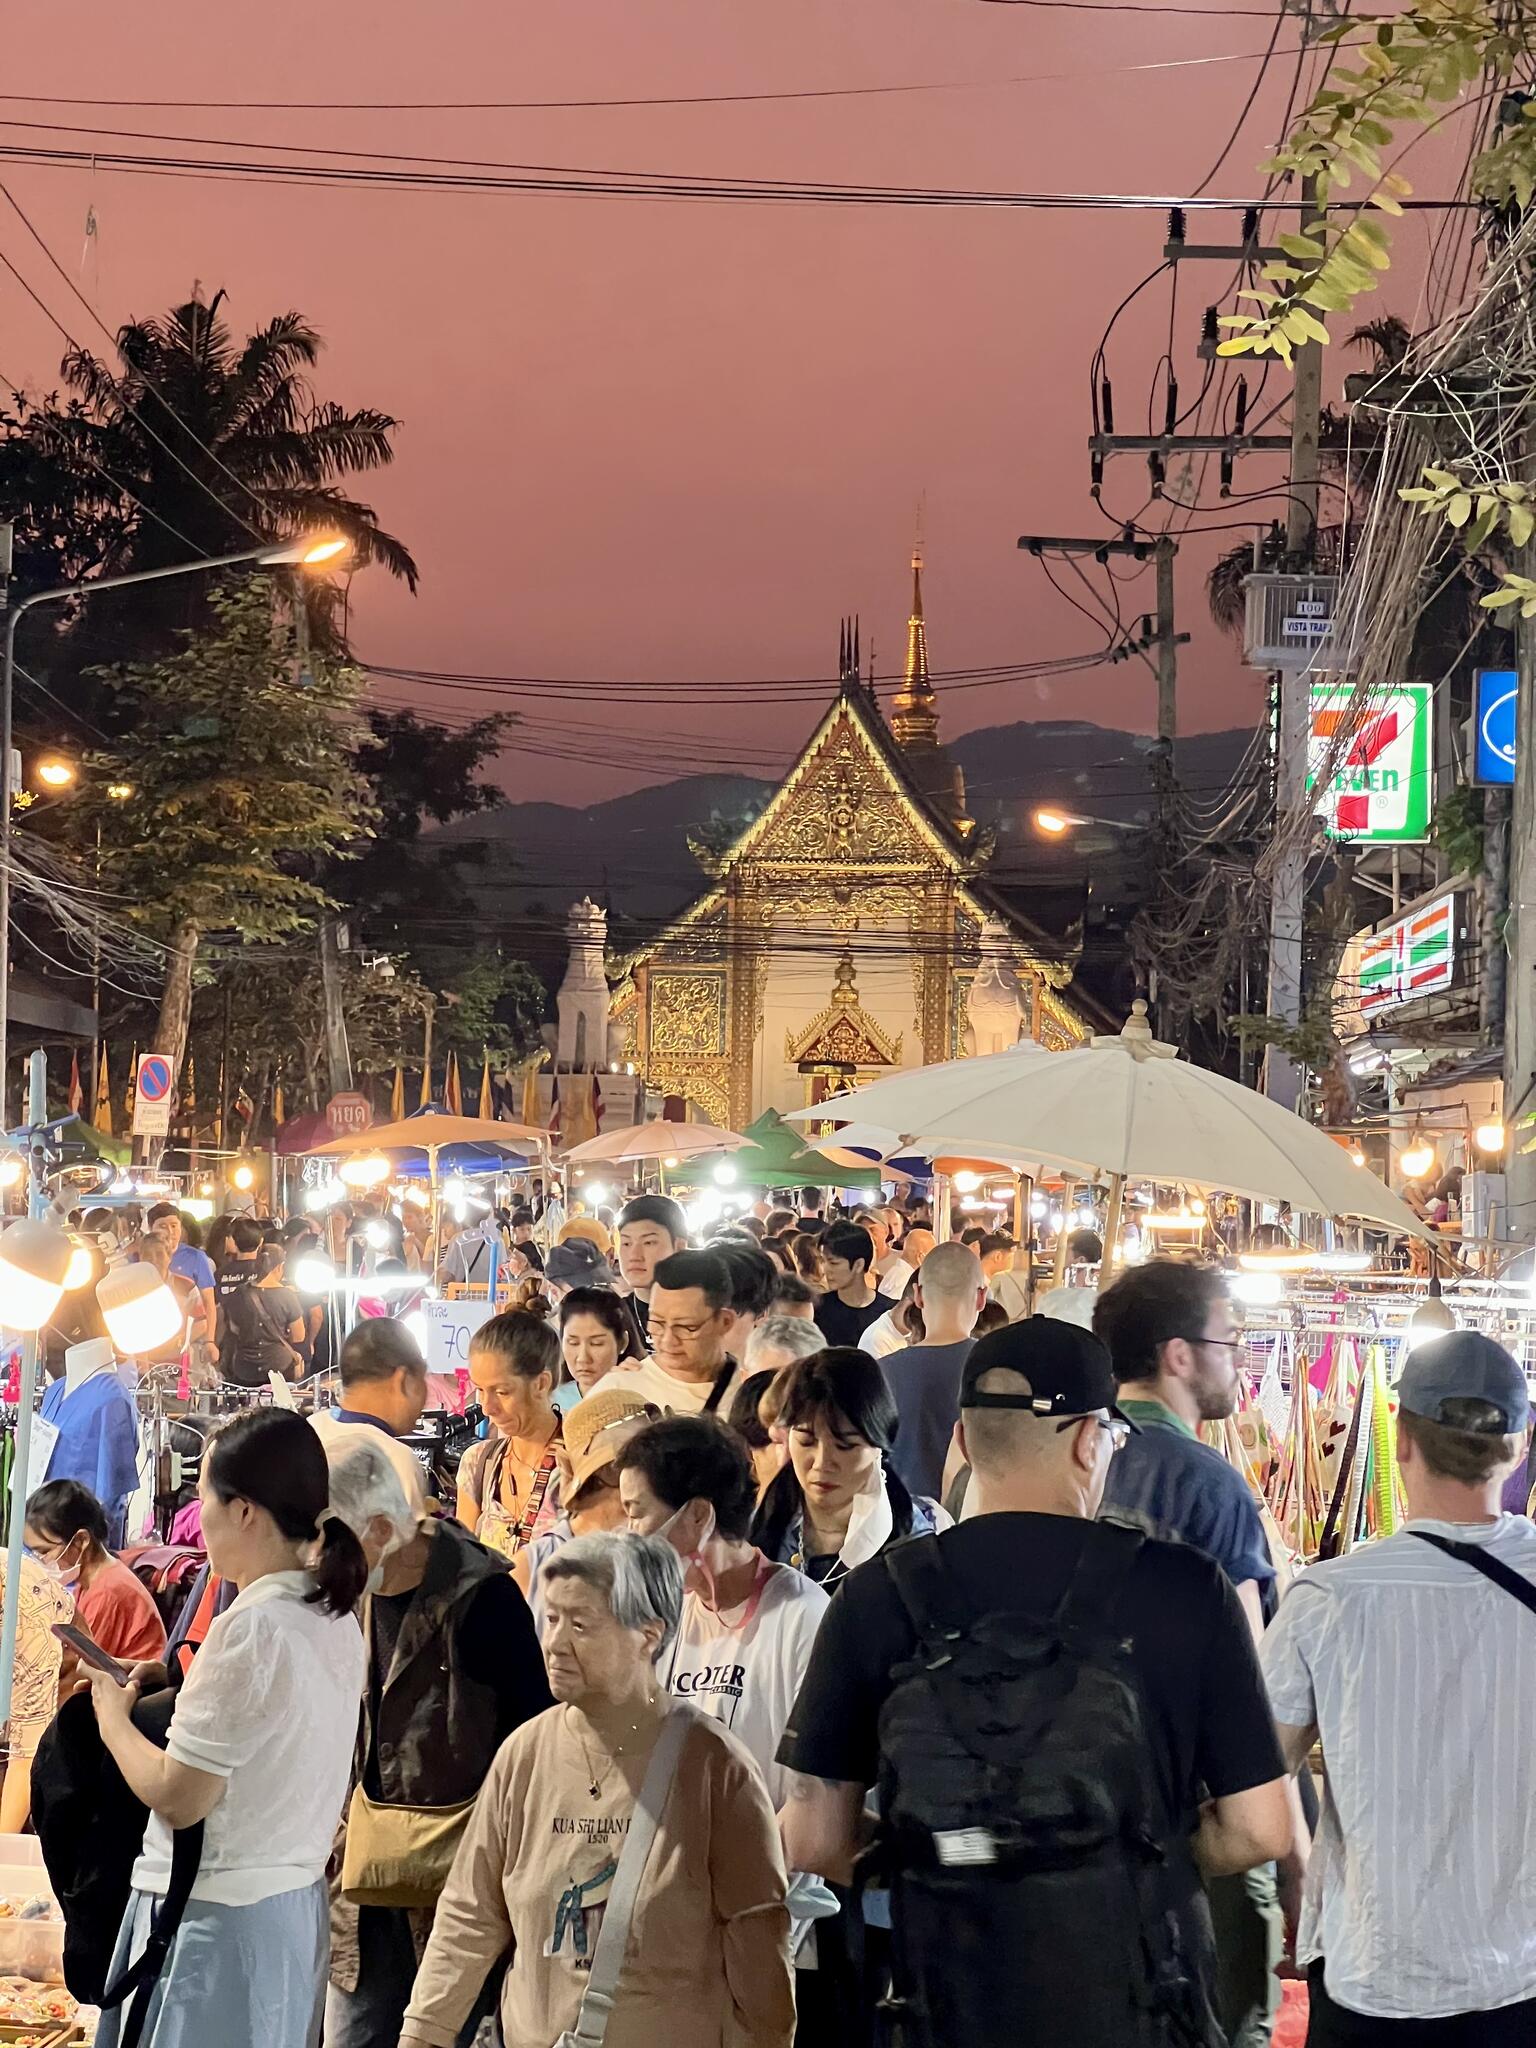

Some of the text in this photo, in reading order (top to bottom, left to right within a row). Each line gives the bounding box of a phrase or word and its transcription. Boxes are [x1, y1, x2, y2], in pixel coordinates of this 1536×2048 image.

[1301, 603, 1322, 613] 100
[1287, 621, 1307, 632] VISTA
[330, 1105, 366, 1132] หยุด
[441, 1326, 472, 1361] 70
[552, 1817, 575, 1834] KUA
[597, 1817, 624, 1834] LIAN
